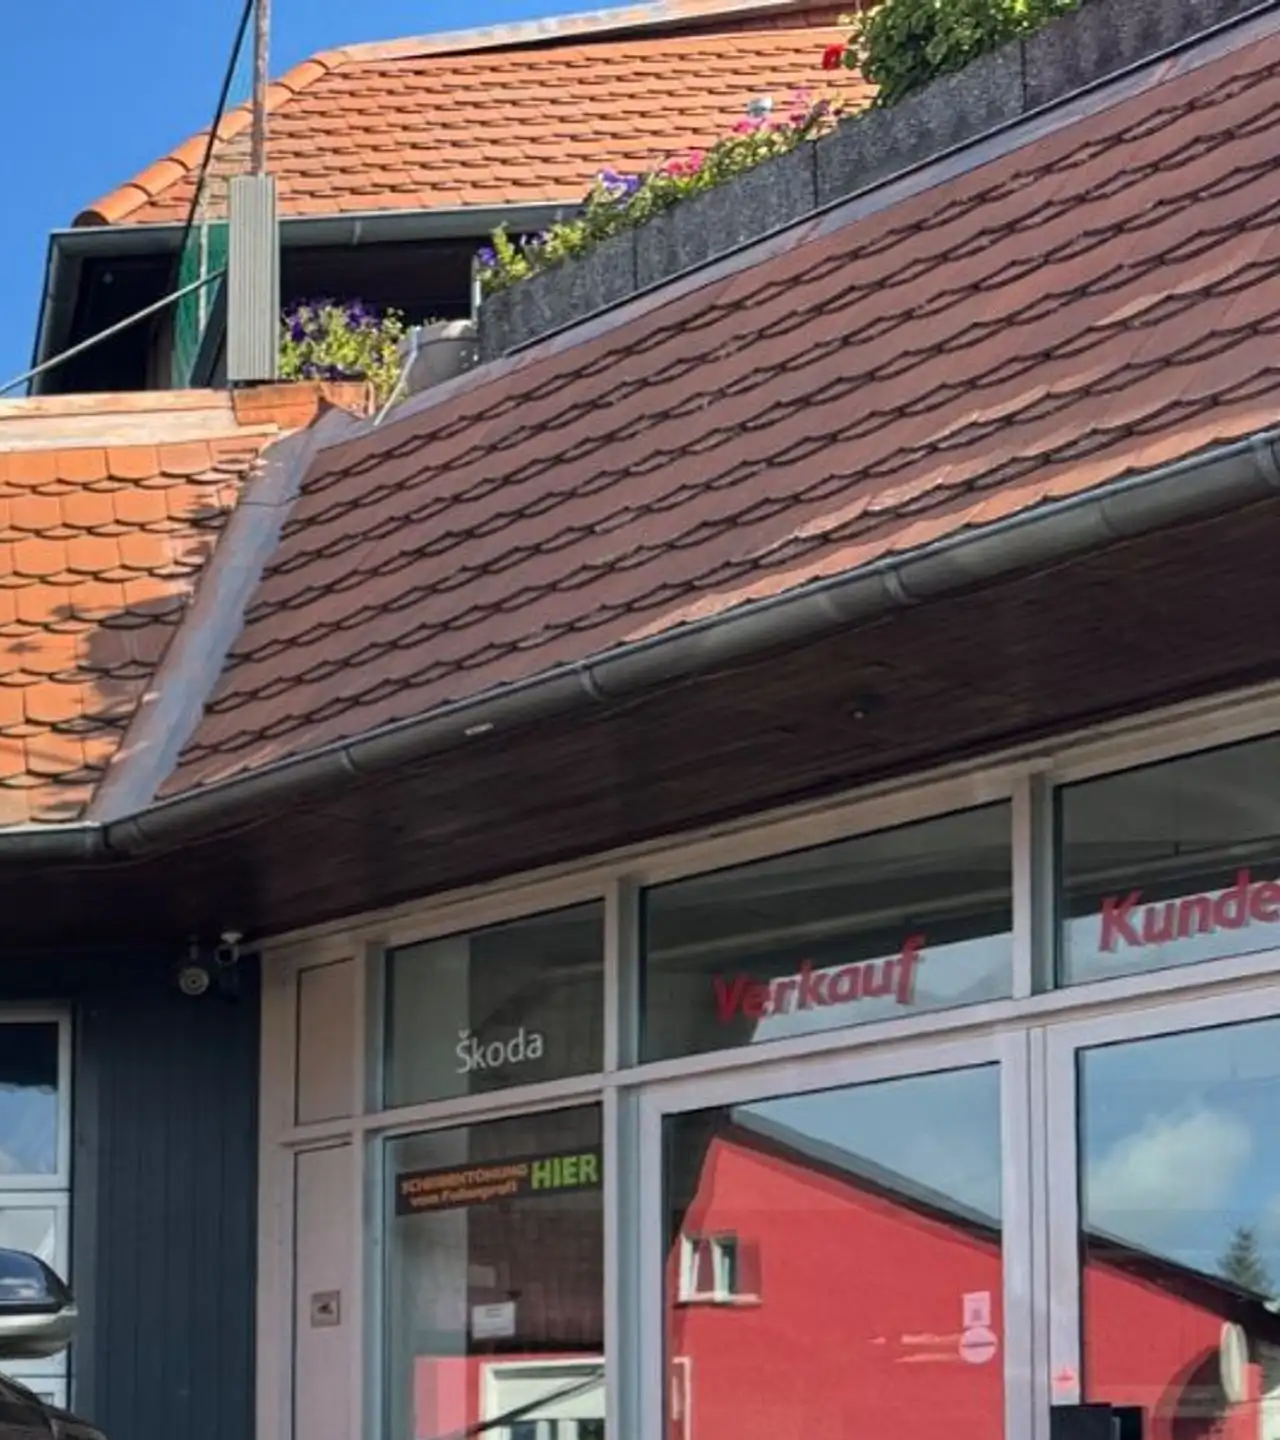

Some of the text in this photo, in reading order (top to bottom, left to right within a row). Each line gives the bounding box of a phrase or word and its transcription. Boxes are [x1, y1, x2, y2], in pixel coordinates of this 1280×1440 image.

[714, 936, 924, 1022] Verkauf
[456, 1028, 543, 1073] Škoda
[531, 1154, 598, 1190] HIER
